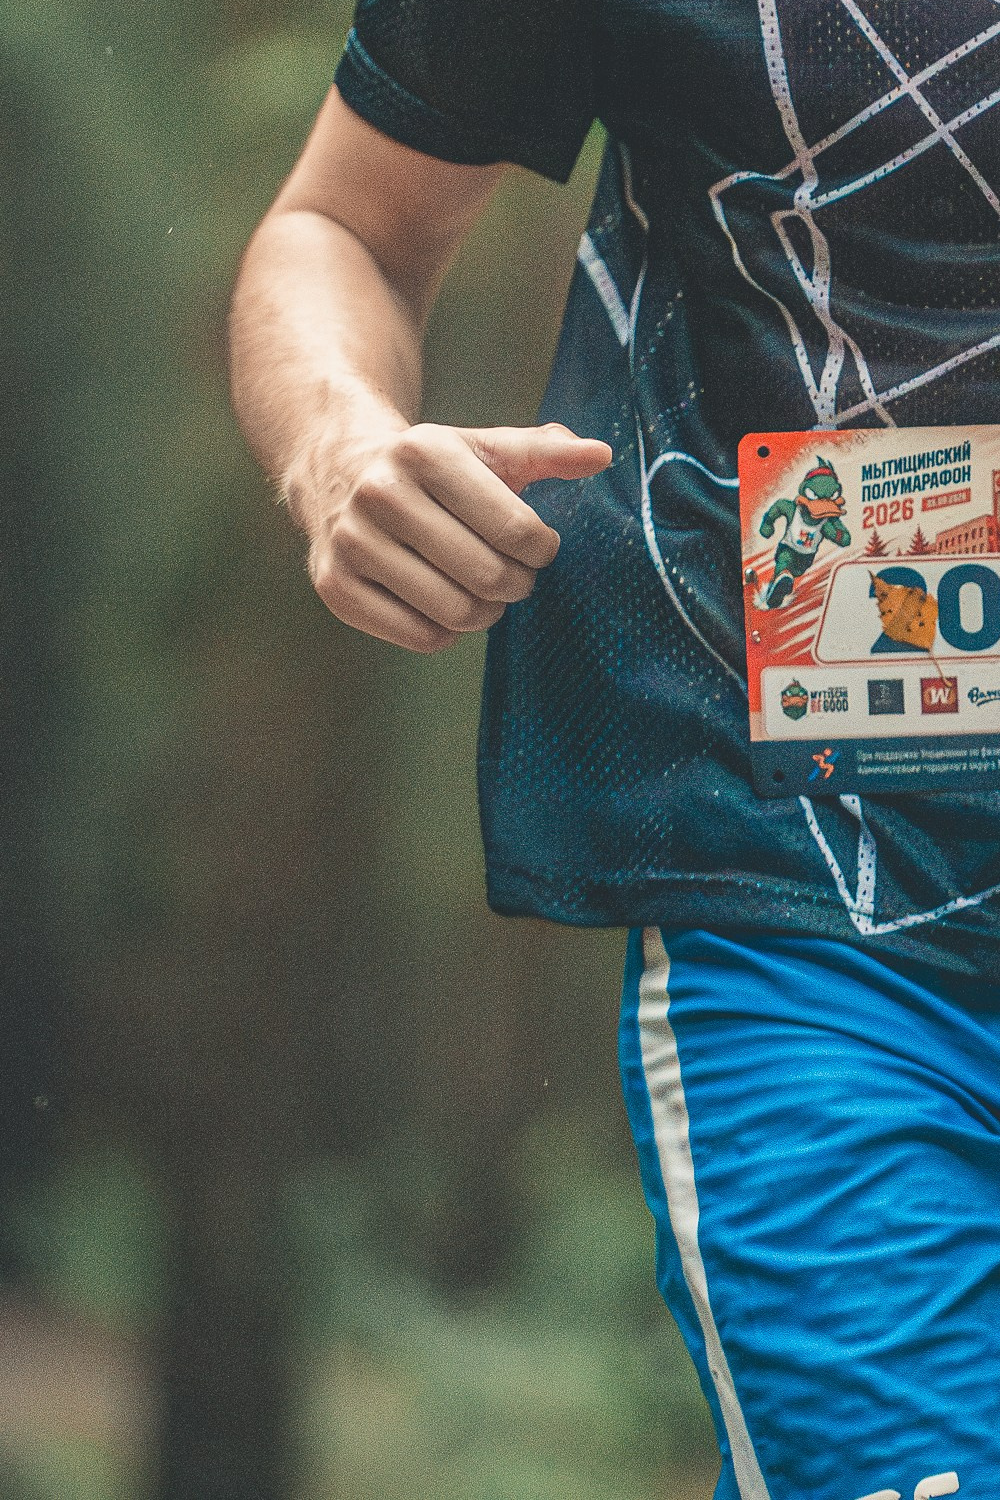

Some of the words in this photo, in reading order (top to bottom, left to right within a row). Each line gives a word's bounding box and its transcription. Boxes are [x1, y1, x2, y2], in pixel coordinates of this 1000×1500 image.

[861, 440, 971, 482] МЫТИЩИНСКИЙ
[861, 465, 972, 502] ПОЛУМАРАФОН
[862, 498, 914, 530] 2026
